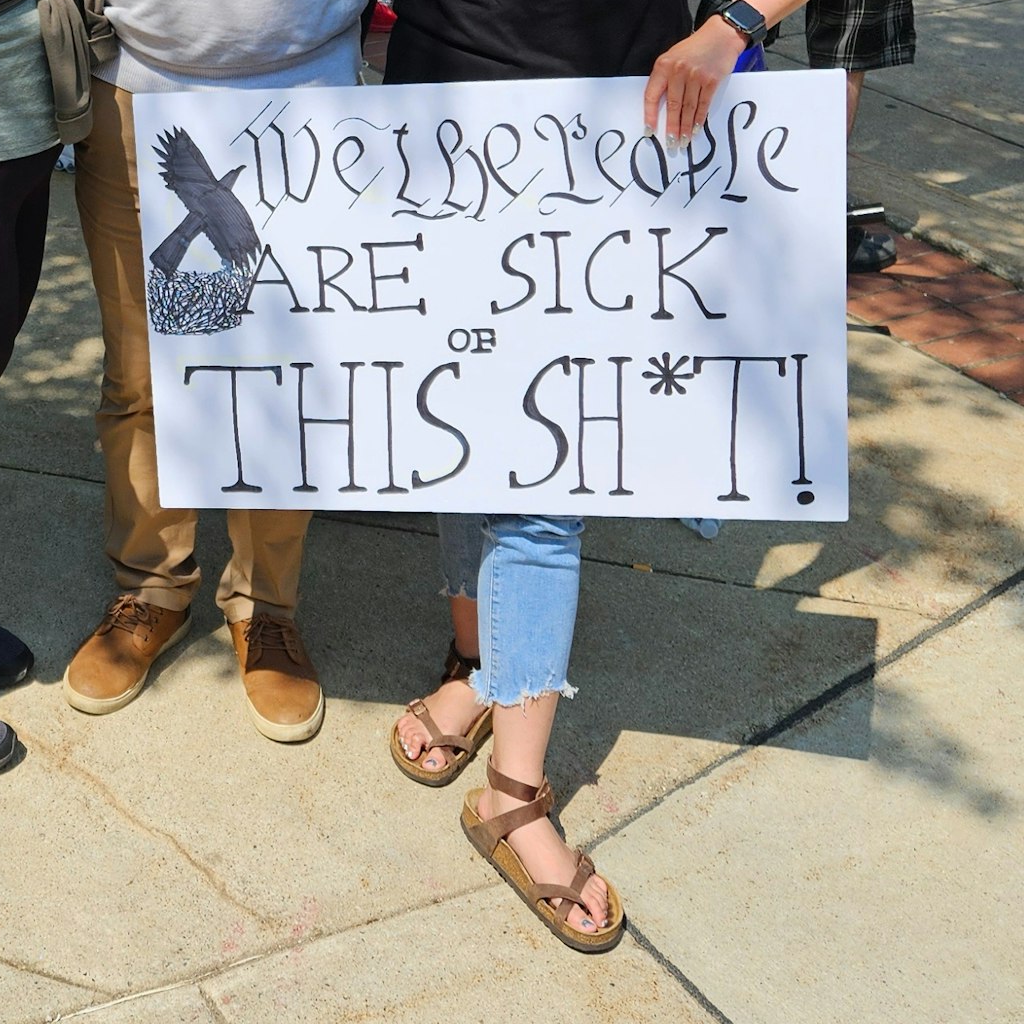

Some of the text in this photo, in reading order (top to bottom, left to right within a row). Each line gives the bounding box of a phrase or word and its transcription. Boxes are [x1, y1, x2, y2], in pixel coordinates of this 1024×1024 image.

[229, 101, 391, 230] We
[236, 227, 728, 320] ARE SICK
[446, 327, 497, 354] OF
[183, 361, 471, 494] THIS
